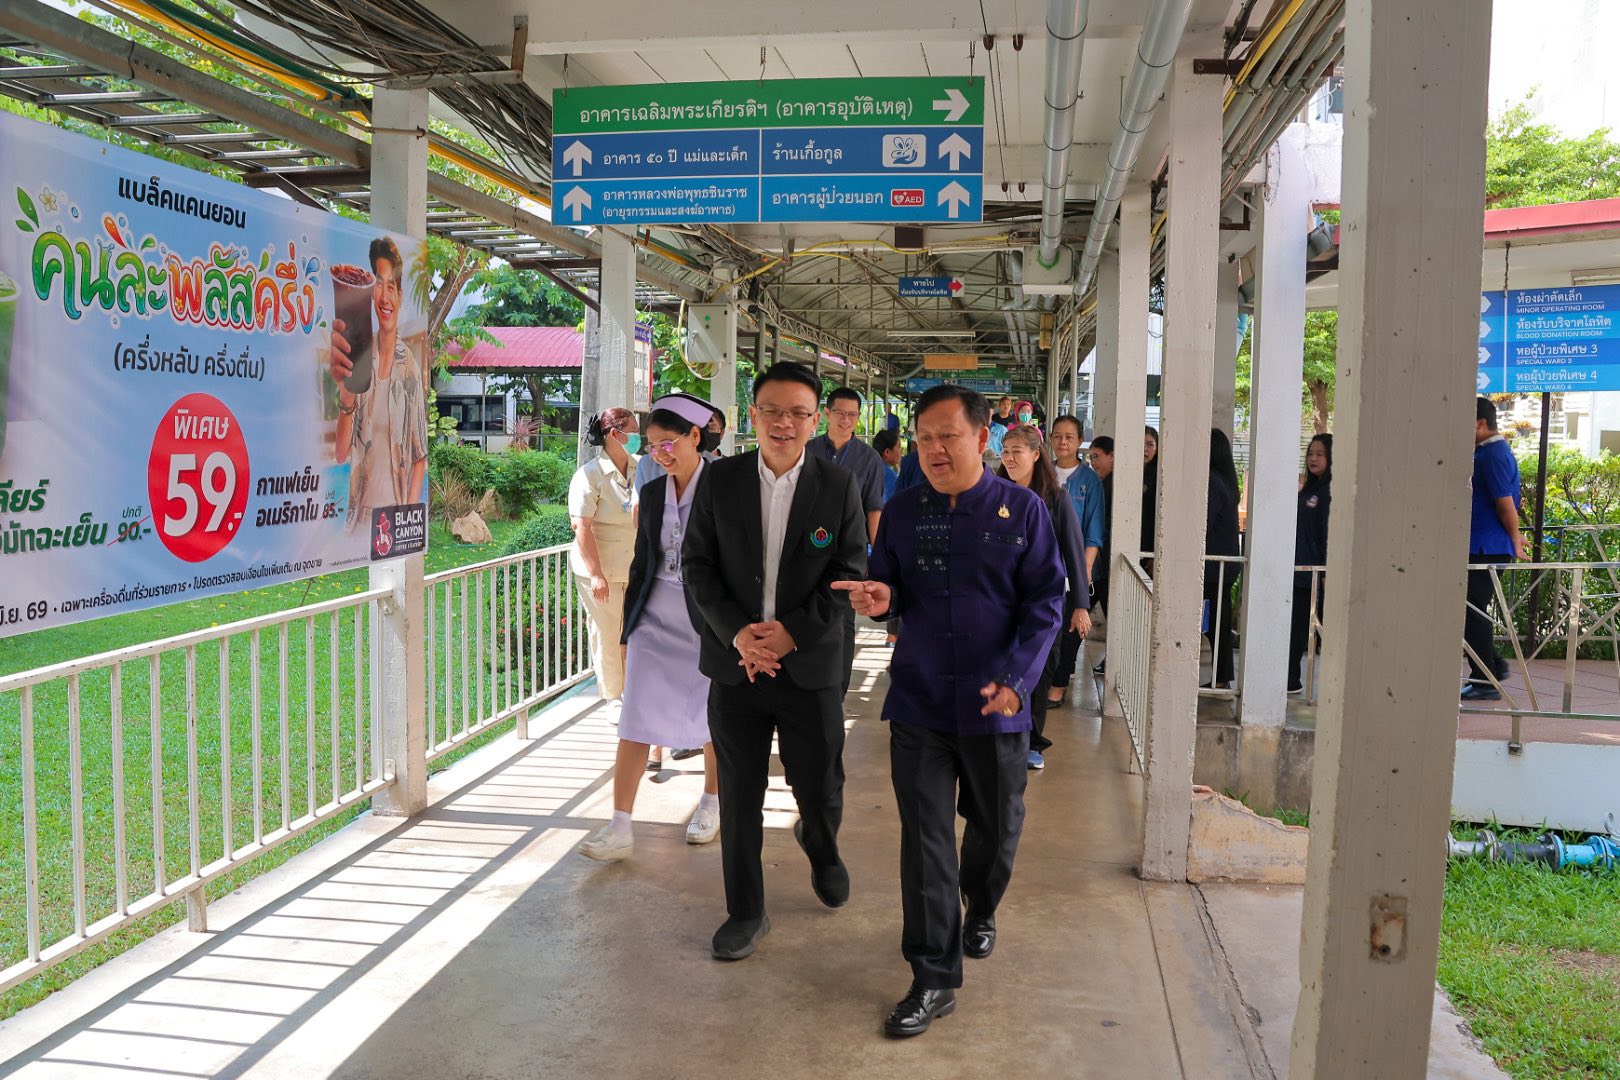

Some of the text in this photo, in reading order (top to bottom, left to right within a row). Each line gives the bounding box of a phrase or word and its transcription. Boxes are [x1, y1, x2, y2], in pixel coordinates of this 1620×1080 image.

[580, 96, 912, 123] อาคารเฉลิมพระเกียรติฯ (อาคารอุบัติเหตุ)
[603, 145, 748, 165] อาคาร ๕๐ ปี แม่และเด็ก
[772, 140, 843, 165] ร้านเกื้อกูล
[118, 177, 247, 229] แบล็คแคนยอน
[603, 185, 748, 203] อาคารหลวงพ่อพุทธชินราช
[772, 185, 884, 209] อาคารผู้ป่วยนอก
[602, 203, 736, 220] (อายุรกรรมและสงฆ์อาพาธ)
[1517, 289, 1582, 304] ห้องผ่าตัดเล็ก
[1516, 306, 1540, 314] MINOR
[1541, 305, 1580, 313] OPERATING
[1517, 315, 1611, 330] ห้องรับบริจาคโลหิต
[1516, 331, 1540, 339] BLOOD
[114, 334, 265, 381] (ครึ่งหลับ ครึ่งตื่น)
[1516, 343, 1598, 358] หอผู้ป่วยพิเศษ 3
[1516, 369, 1598, 384] หอผู้ป่วยพิเศษ 4
[174, 409, 229, 440] พิเศษ
[257, 466, 319, 496] กาแฟเย็น
[163, 452, 243, 532] 59.-
[122, 505, 142, 518] ปกติ
[255, 500, 318, 528] อเมริกาโน
[395, 509, 423, 526] BLACK
[0, 512, 107, 555] มัทฉะเย็น
[117, 520, 151, 543] 90.-
[395, 524, 424, 539] CANYON
[27, 600, 48, 620] 69
[61, 582, 187, 613] เฉพาะเครื่องดื่มที่ร่วมรายการ
[294, 562, 302, 572] ณ
